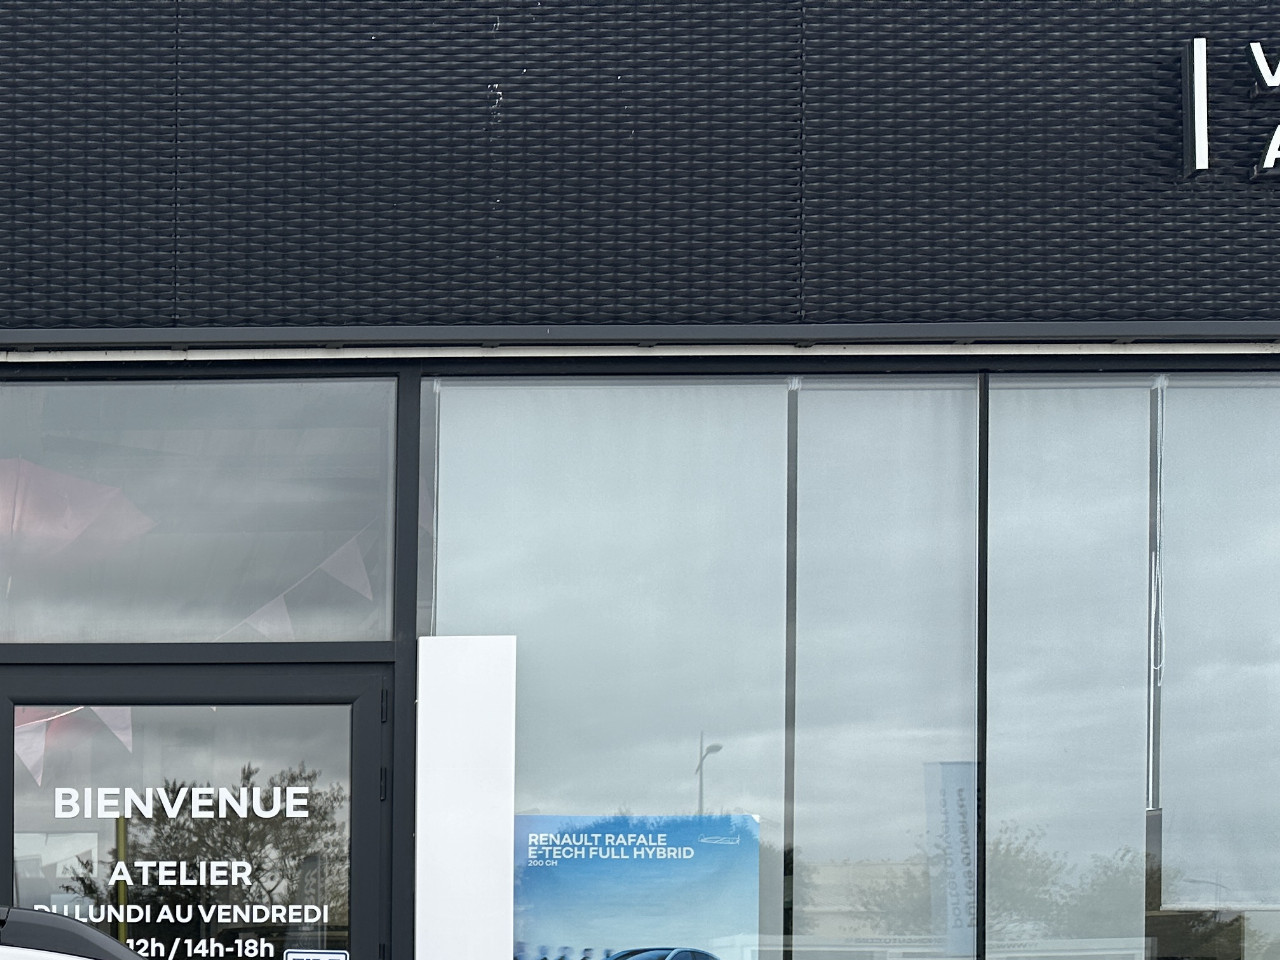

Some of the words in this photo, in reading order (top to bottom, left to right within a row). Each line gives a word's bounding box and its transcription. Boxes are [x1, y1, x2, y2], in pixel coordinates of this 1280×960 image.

[54, 787, 310, 819] BIENVENUE
[528, 833, 602, 846] RENAULT
[605, 833, 667, 846] RAFALE
[528, 847, 586, 859] E-TECH
[589, 847, 629, 859] FULL
[633, 847, 695, 859] HYBRID
[108, 860, 253, 886] ATELIER
[74, 904, 151, 923] LUNDI
[156, 905, 193, 923] AU
[198, 904, 329, 923] VENDREDI
[184, 938, 275, 958] 14h-18h
